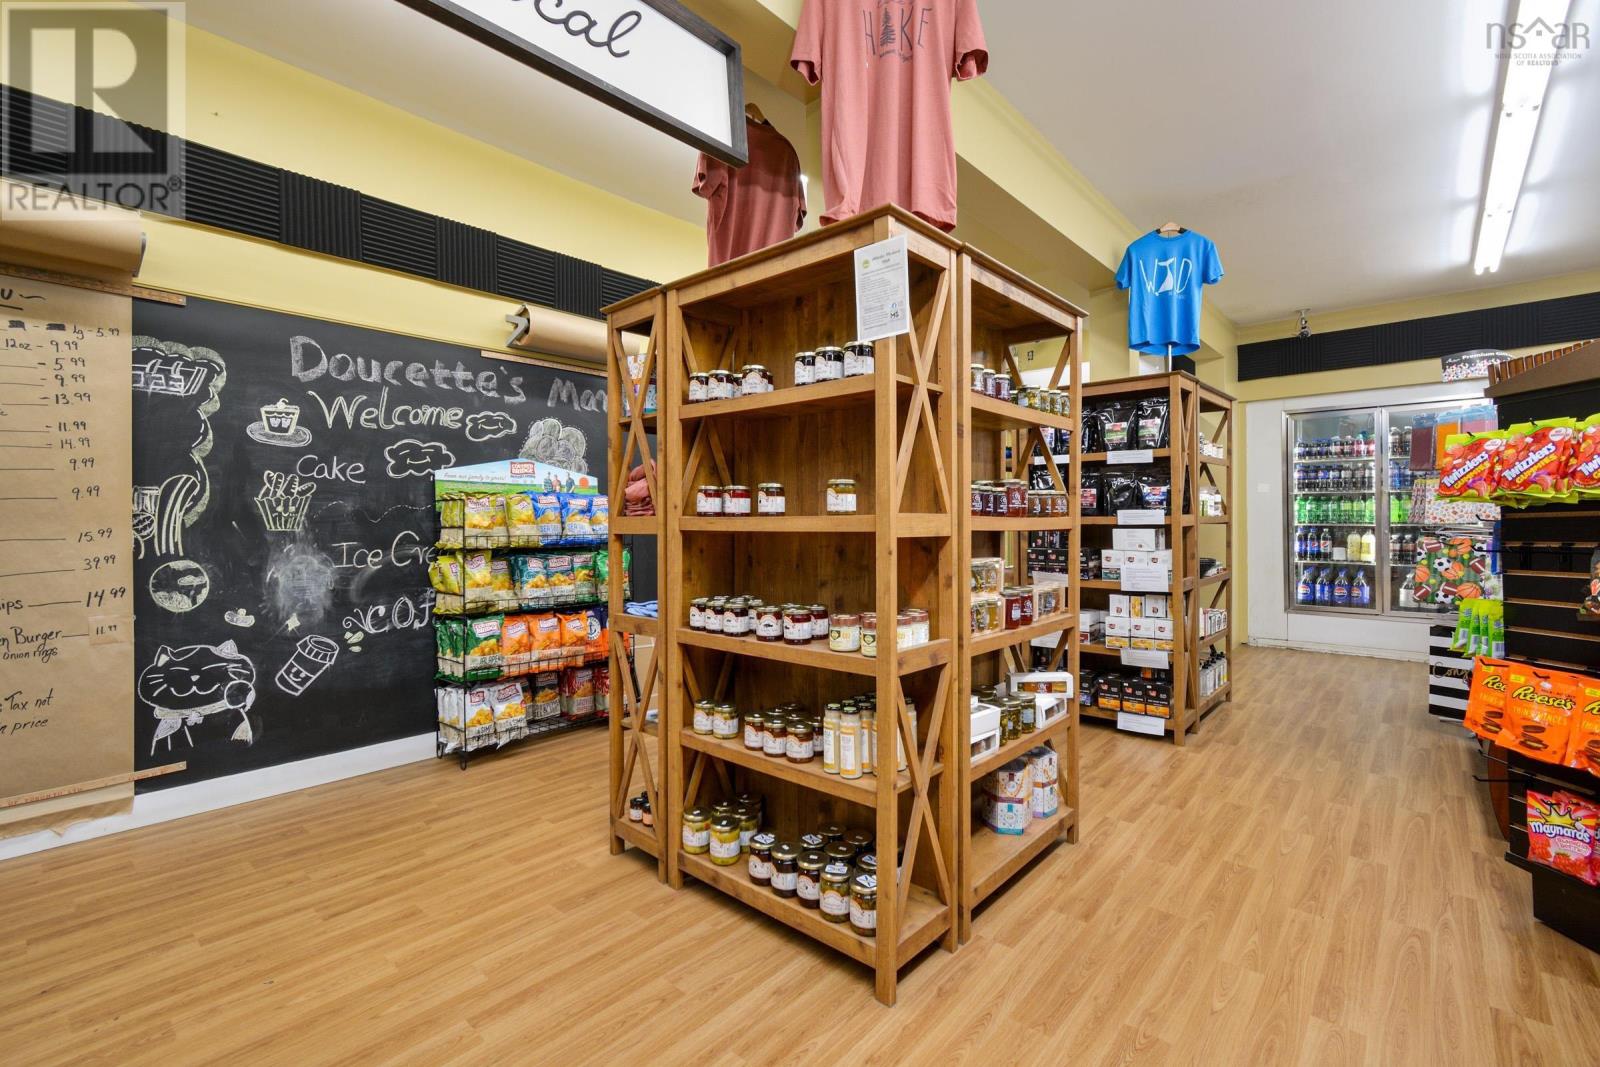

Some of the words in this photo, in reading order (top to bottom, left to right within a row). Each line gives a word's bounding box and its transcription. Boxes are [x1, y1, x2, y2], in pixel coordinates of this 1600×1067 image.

[54, 357, 86, 371] 5.99
[290, 335, 527, 404] Doucette's
[54, 373, 86, 387] 9.99
[55, 392, 91, 405] 13.99
[307, 386, 464, 430] Welcome
[58, 420, 87, 432] 11.99
[60, 436, 90, 449] 14.99
[69, 457, 95, 471] 9.99
[296, 454, 366, 484] Cake
[1441, 451, 1489, 488] Twizzlers
[1501, 442, 1556, 481] Twizzlers
[72, 485, 100, 501] 9.99
[78, 527, 113, 543] 15.99
[331, 541, 383, 570] Ice
[10, 626, 62, 650] Burger
[3, 651, 30, 661] onion
[4, 690, 29, 711] Tax
[35, 688, 54, 708] not
[1512, 685, 1577, 711] Reese's
[10, 718, 49, 736] price
